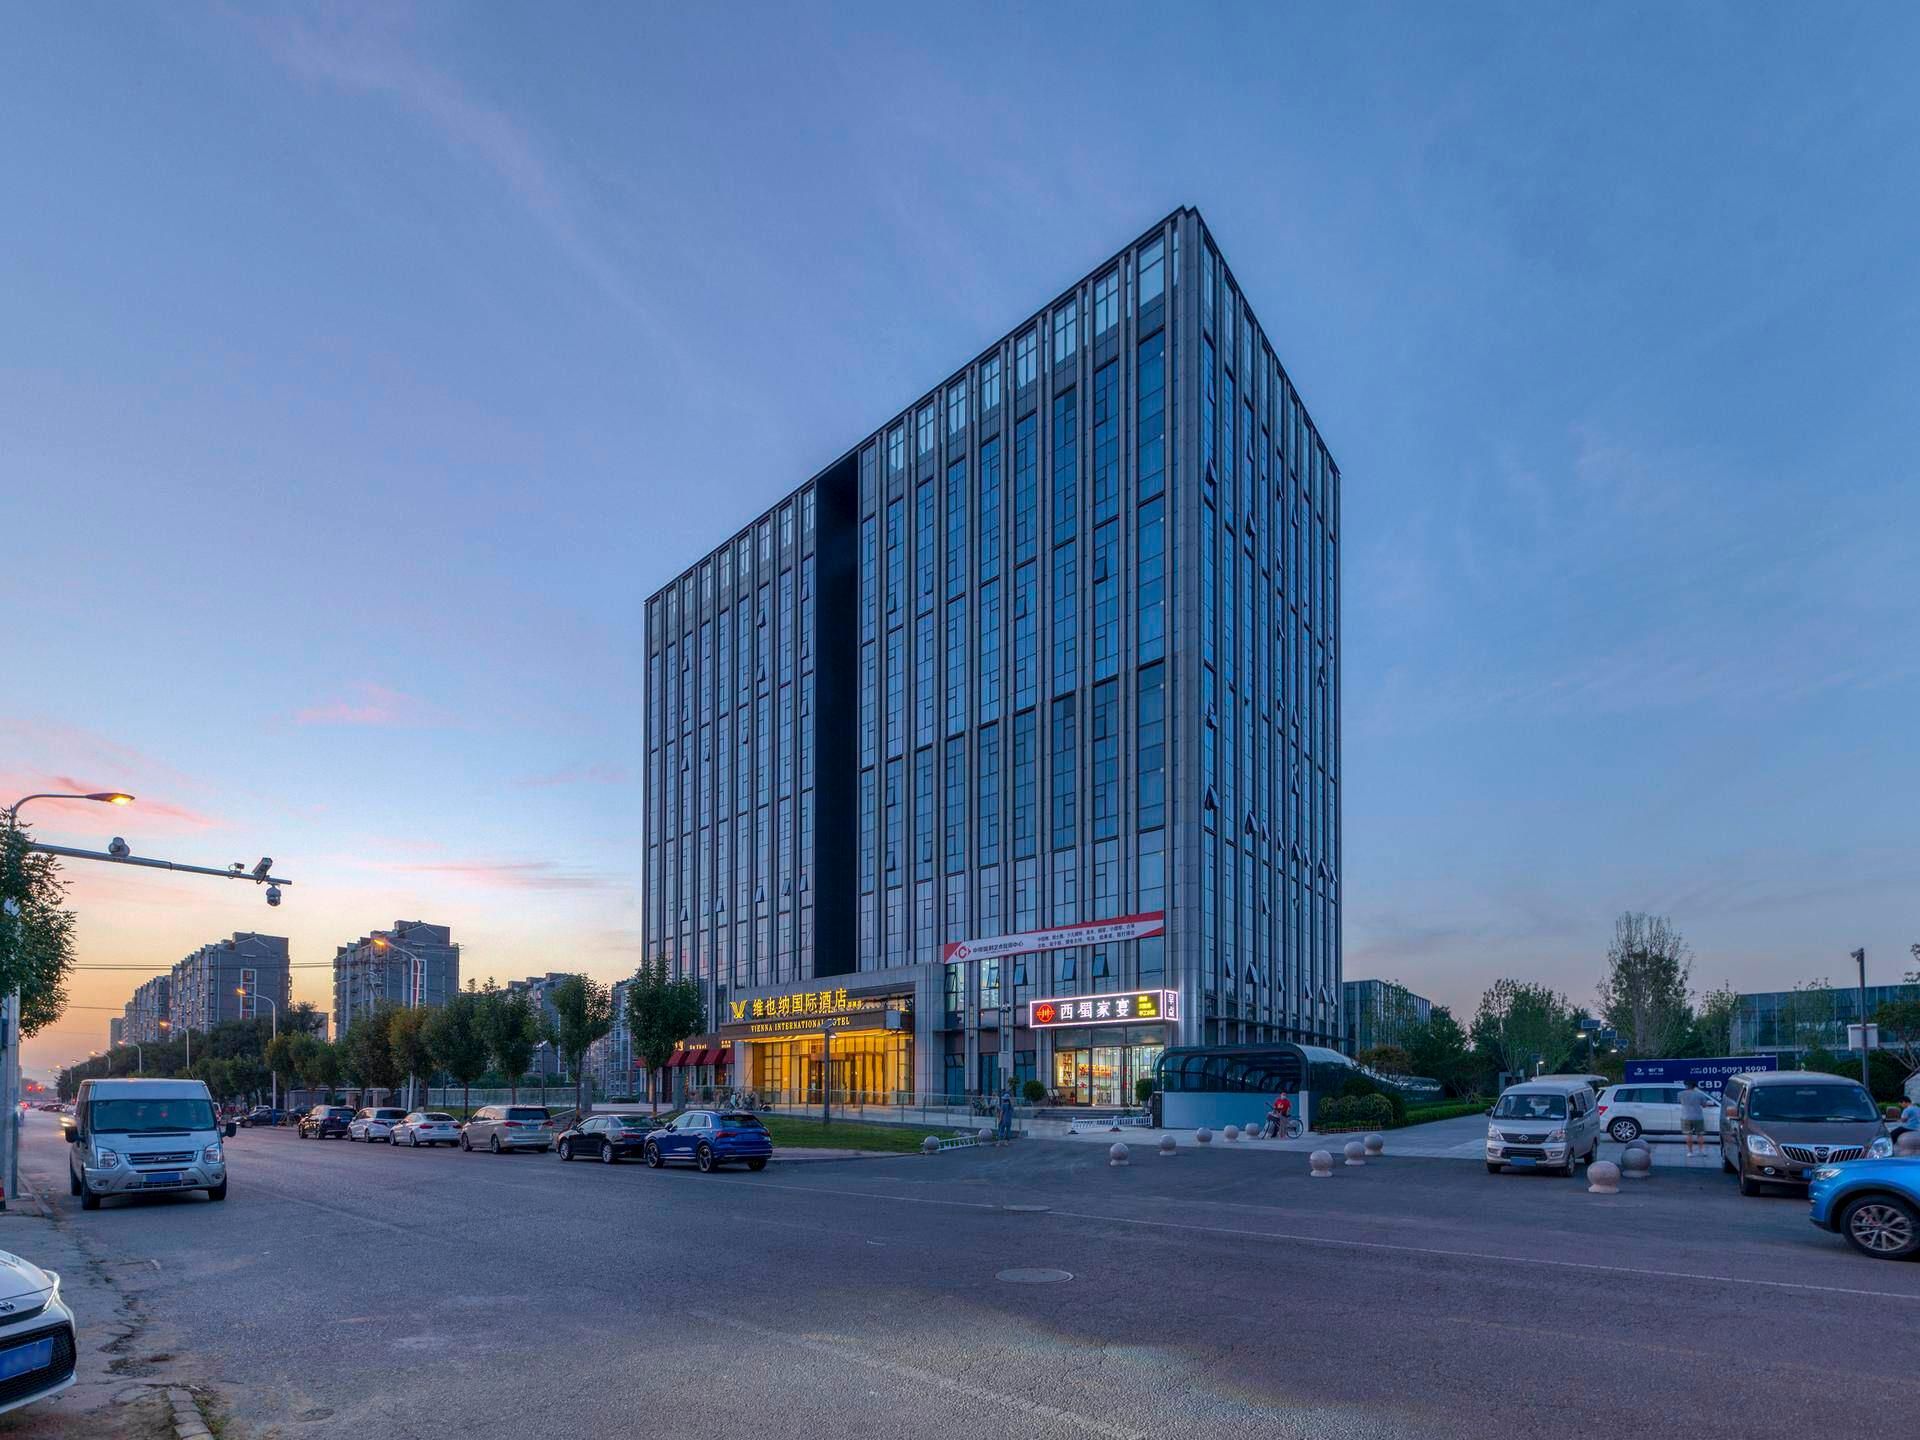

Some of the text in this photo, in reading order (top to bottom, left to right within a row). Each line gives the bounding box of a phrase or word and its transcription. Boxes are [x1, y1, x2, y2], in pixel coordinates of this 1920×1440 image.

[752, 988, 848, 1018] 维也纳国际酒店
[1060, 998, 1130, 1020] 西蜀家宴
[751, 1024, 773, 1033] VIENNA
[827, 1017, 850, 1027] OTEL
[1702, 1066, 1743, 1075] 010-5093
[1697, 1080, 1722, 1088] CBD
